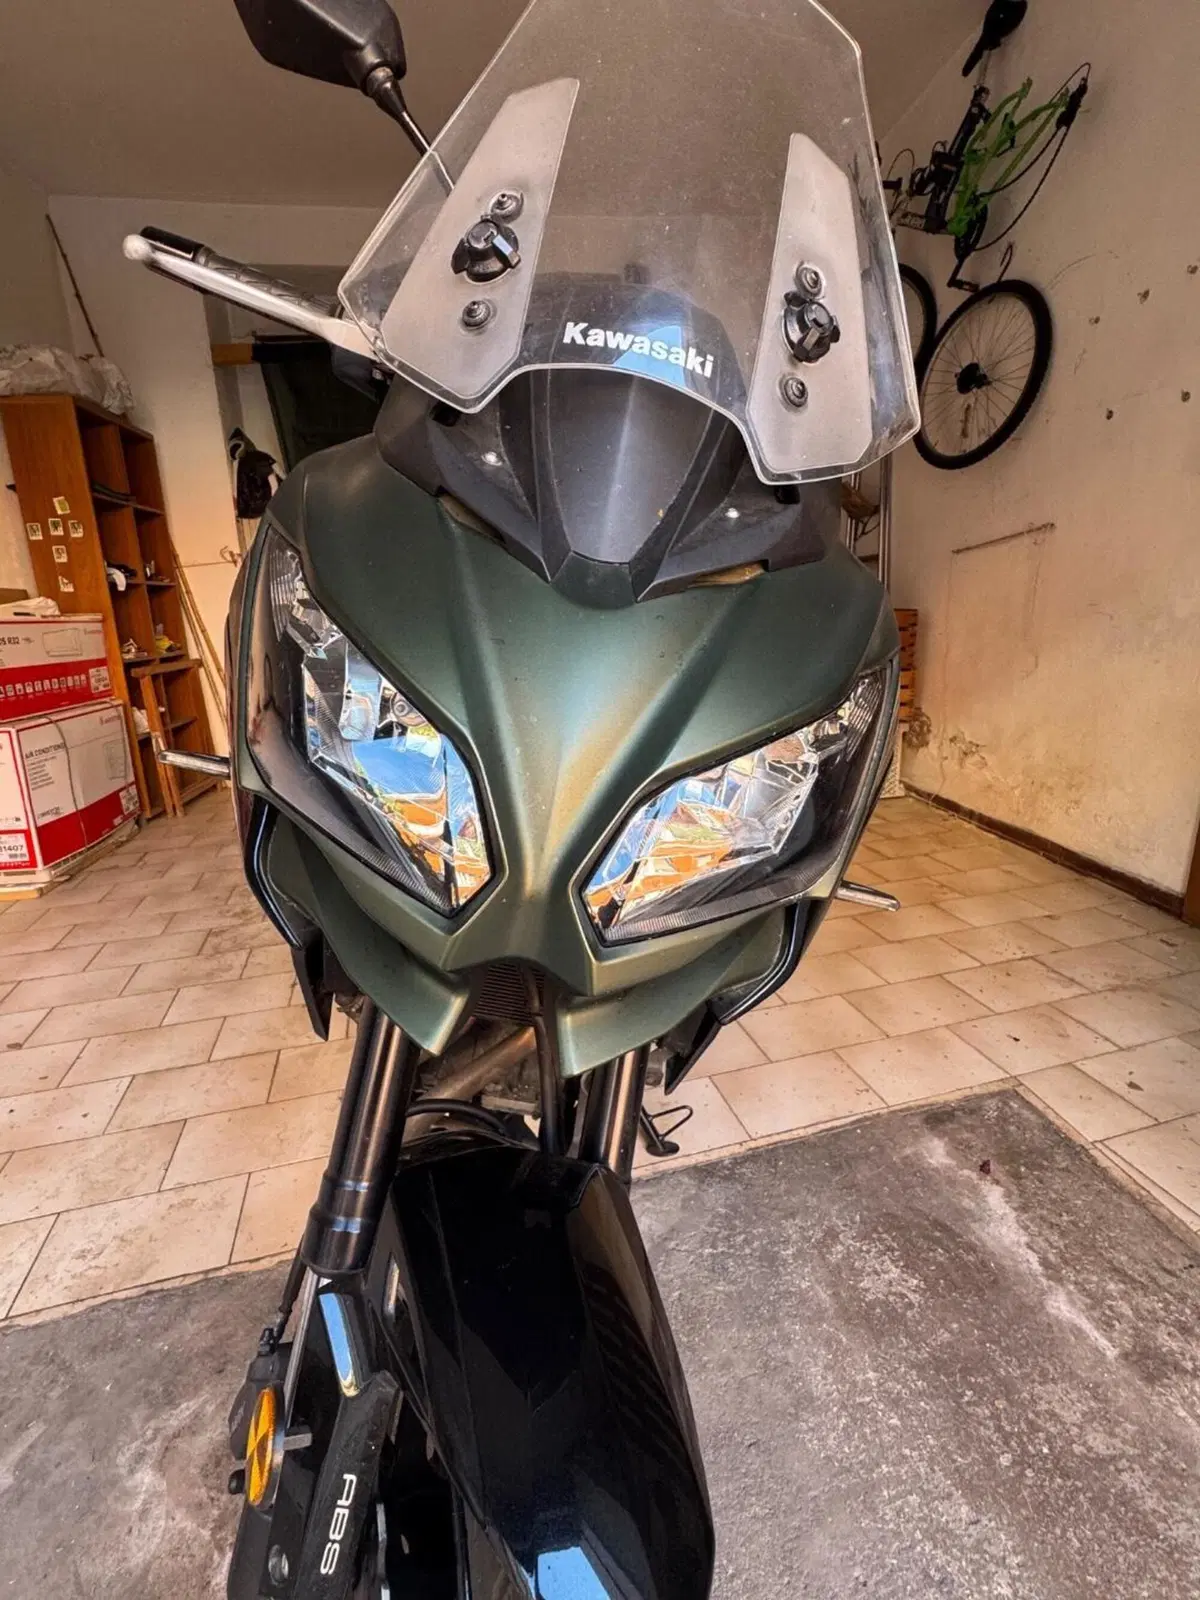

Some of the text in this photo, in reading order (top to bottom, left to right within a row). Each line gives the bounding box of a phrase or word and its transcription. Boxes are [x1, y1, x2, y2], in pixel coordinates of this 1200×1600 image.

[563, 321, 714, 378] Kawasaki
[25, 750, 34, 759] AIR
[320, 1473, 358, 1575] ABS
